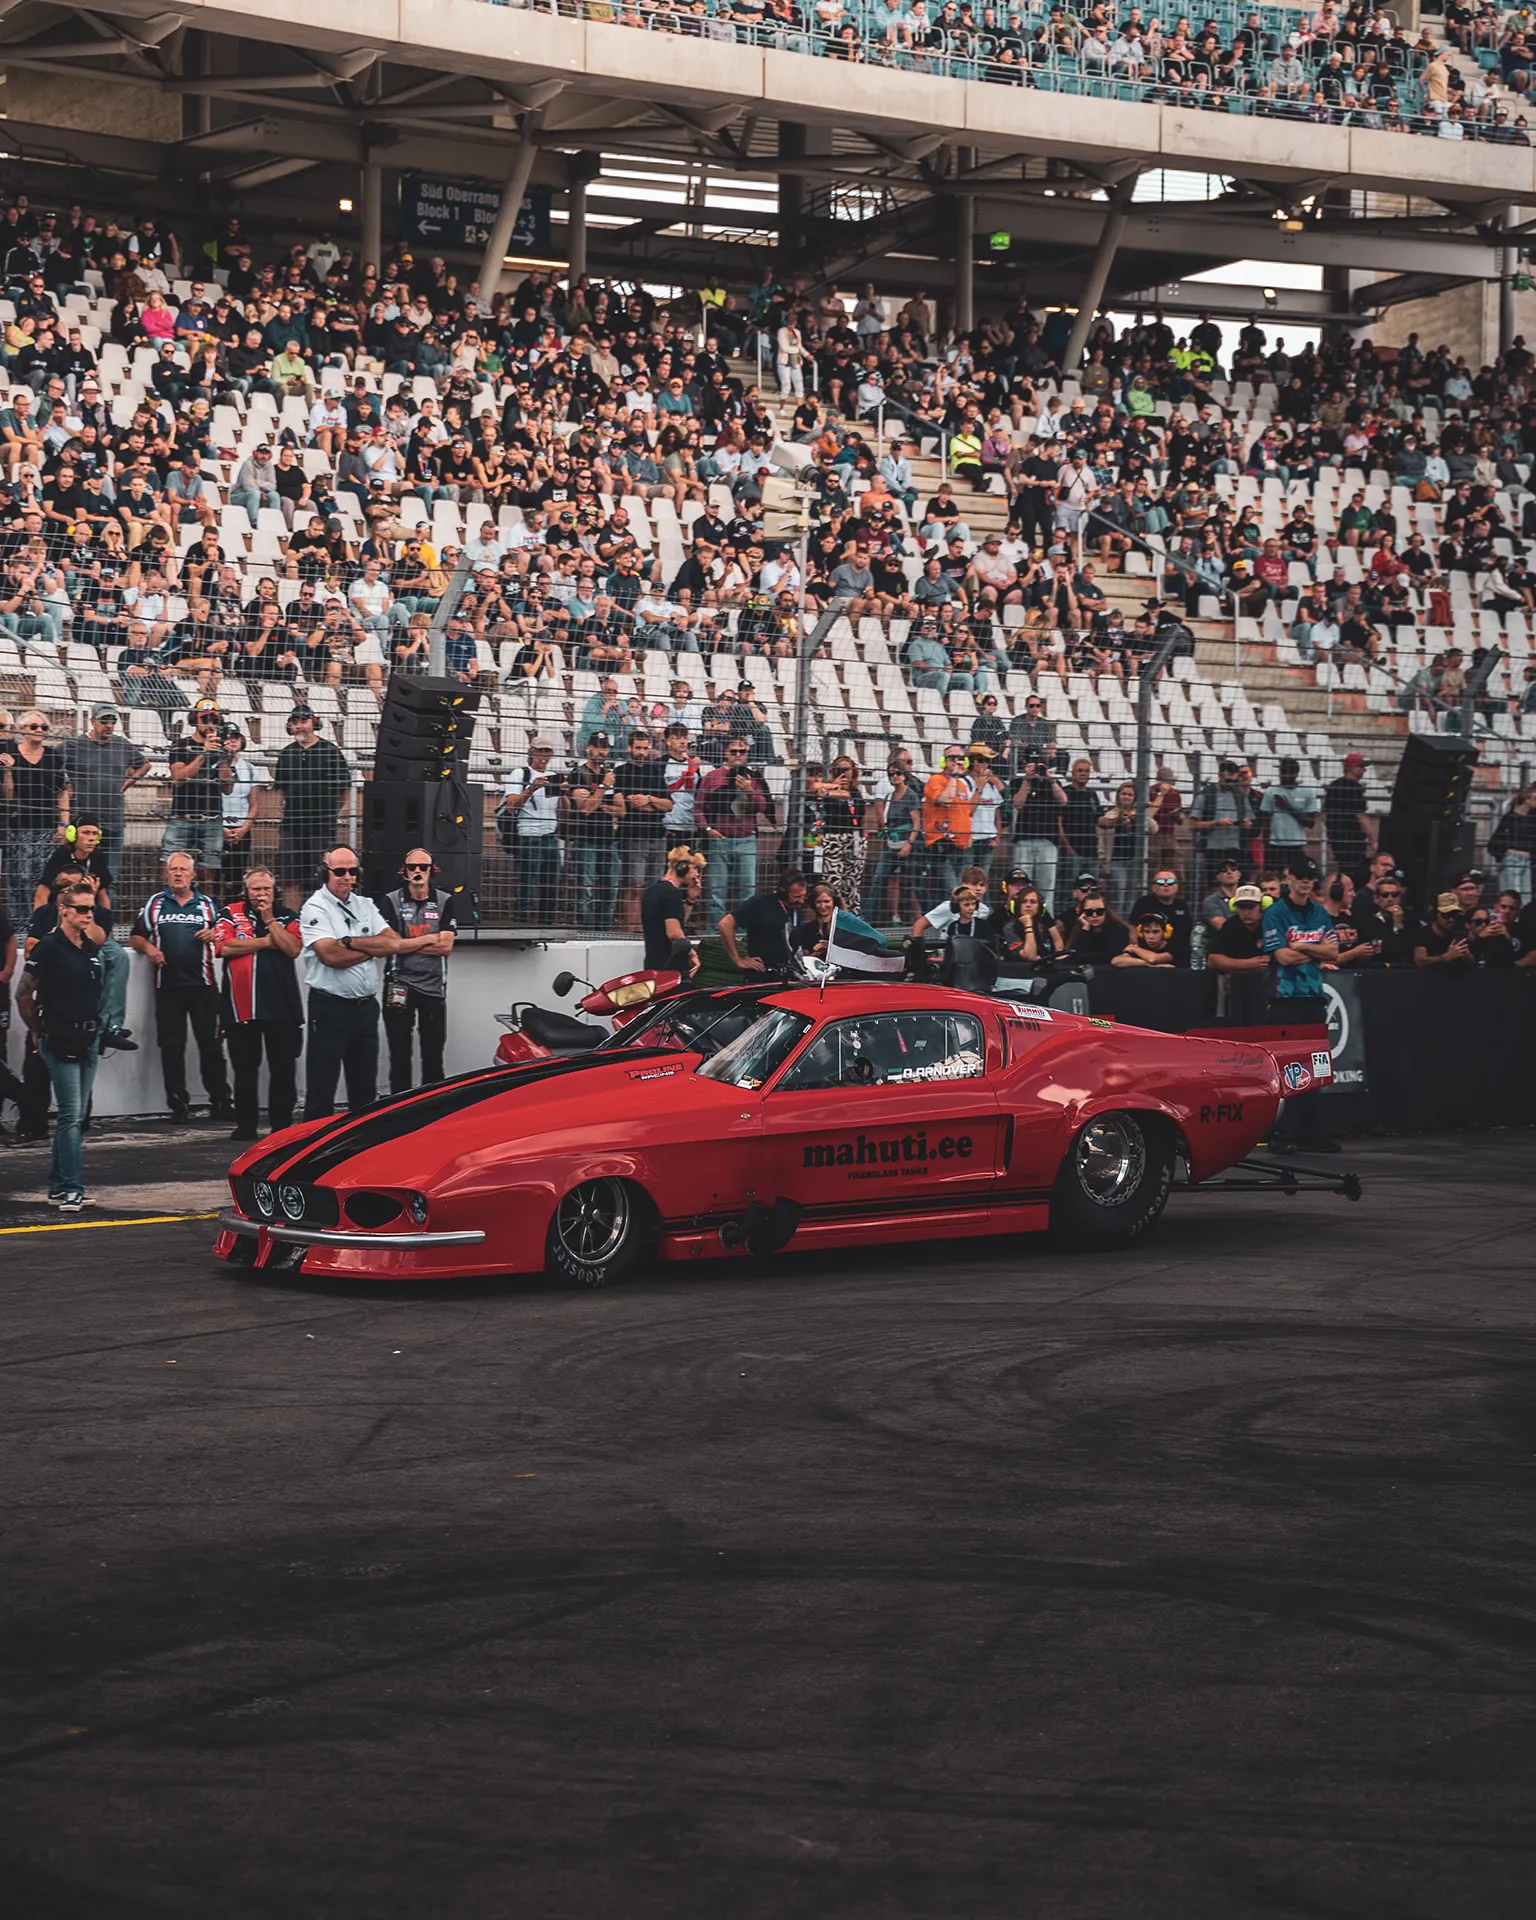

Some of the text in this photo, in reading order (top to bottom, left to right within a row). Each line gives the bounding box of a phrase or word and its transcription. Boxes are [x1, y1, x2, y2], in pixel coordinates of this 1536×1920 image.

[421, 183, 442, 199] Süd
[447, 187, 499, 207] Oberrang
[417, 202, 449, 219] Block
[454, 206, 459, 220] 1
[474, 208, 498, 224] Bloc
[528, 215, 535, 229] 3
[158, 913, 204, 922] LUCAS
[1284, 1062, 1303, 1089] VP
[802, 1131, 974, 1168] mahuti.ee
